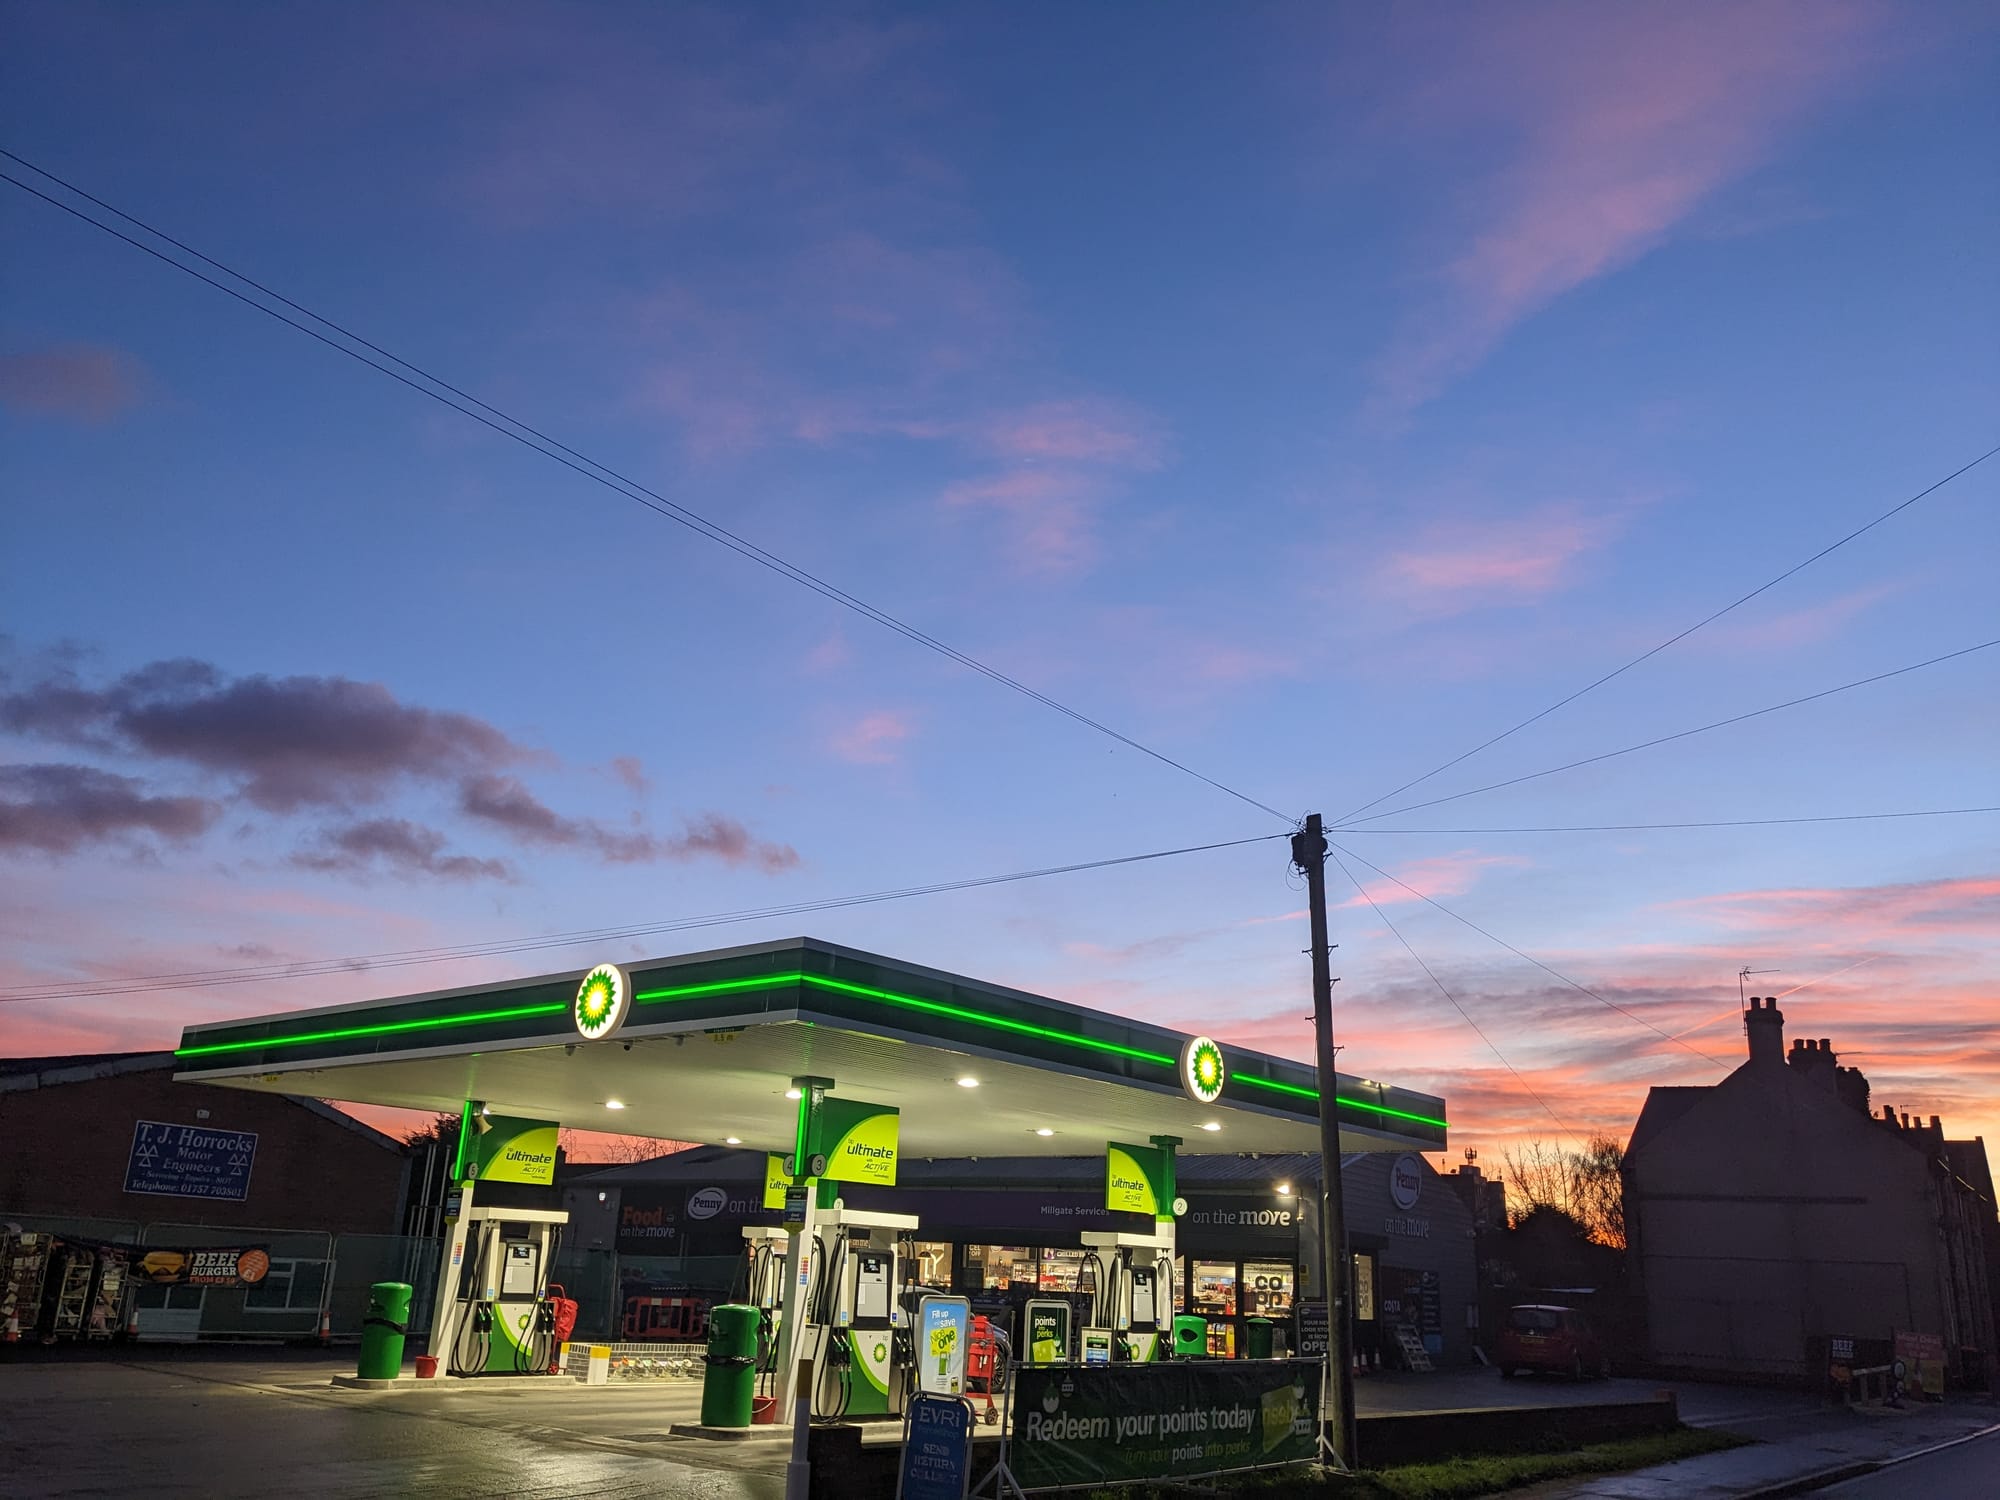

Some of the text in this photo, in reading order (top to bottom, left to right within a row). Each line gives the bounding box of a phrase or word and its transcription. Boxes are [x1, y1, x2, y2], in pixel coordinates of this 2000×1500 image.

[141, 1123, 254, 1153] T. J. Horrocks
[177, 1147, 214, 1160] Motor
[506, 1150, 552, 1164] ultimate
[847, 1142, 893, 1160] ultimate
[163, 1158, 222, 1174] Engineers
[787, 1160, 793, 1171] 4
[816, 1159, 822, 1171] 3
[1112, 1177, 1144, 1191] ultimate
[1395, 1167, 1421, 1196] Penny
[693, 1196, 764, 1214] Penny on th
[1040, 1205, 1073, 1216] Millgate
[1177, 1202, 1183, 1211] 2
[622, 1206, 663, 1226] Food
[1192, 1209, 1291, 1226] on the move
[620, 1226, 675, 1239] on the move
[192, 1252, 240, 1267] BEEF
[191, 1266, 237, 1276] BURGER
[1384, 1299, 1401, 1313] COSTA
[931, 1309, 949, 1319] Fill up
[940, 1318, 956, 1328] save
[1035, 1315, 1057, 1328] points
[938, 1330, 956, 1350] one
[1036, 1329, 1054, 1340] perks
[1025, 1411, 1110, 1441] Redeem
[1114, 1416, 1156, 1444] your
[1158, 1406, 1207, 1441] points
[1210, 1402, 1256, 1434] today
[922, 1443, 950, 1457] SEND
[1172, 1442, 1203, 1465] points
[1205, 1440, 1223, 1457] into
[1224, 1440, 1251, 1457] perks
[911, 1468, 958, 1484] COLLET
